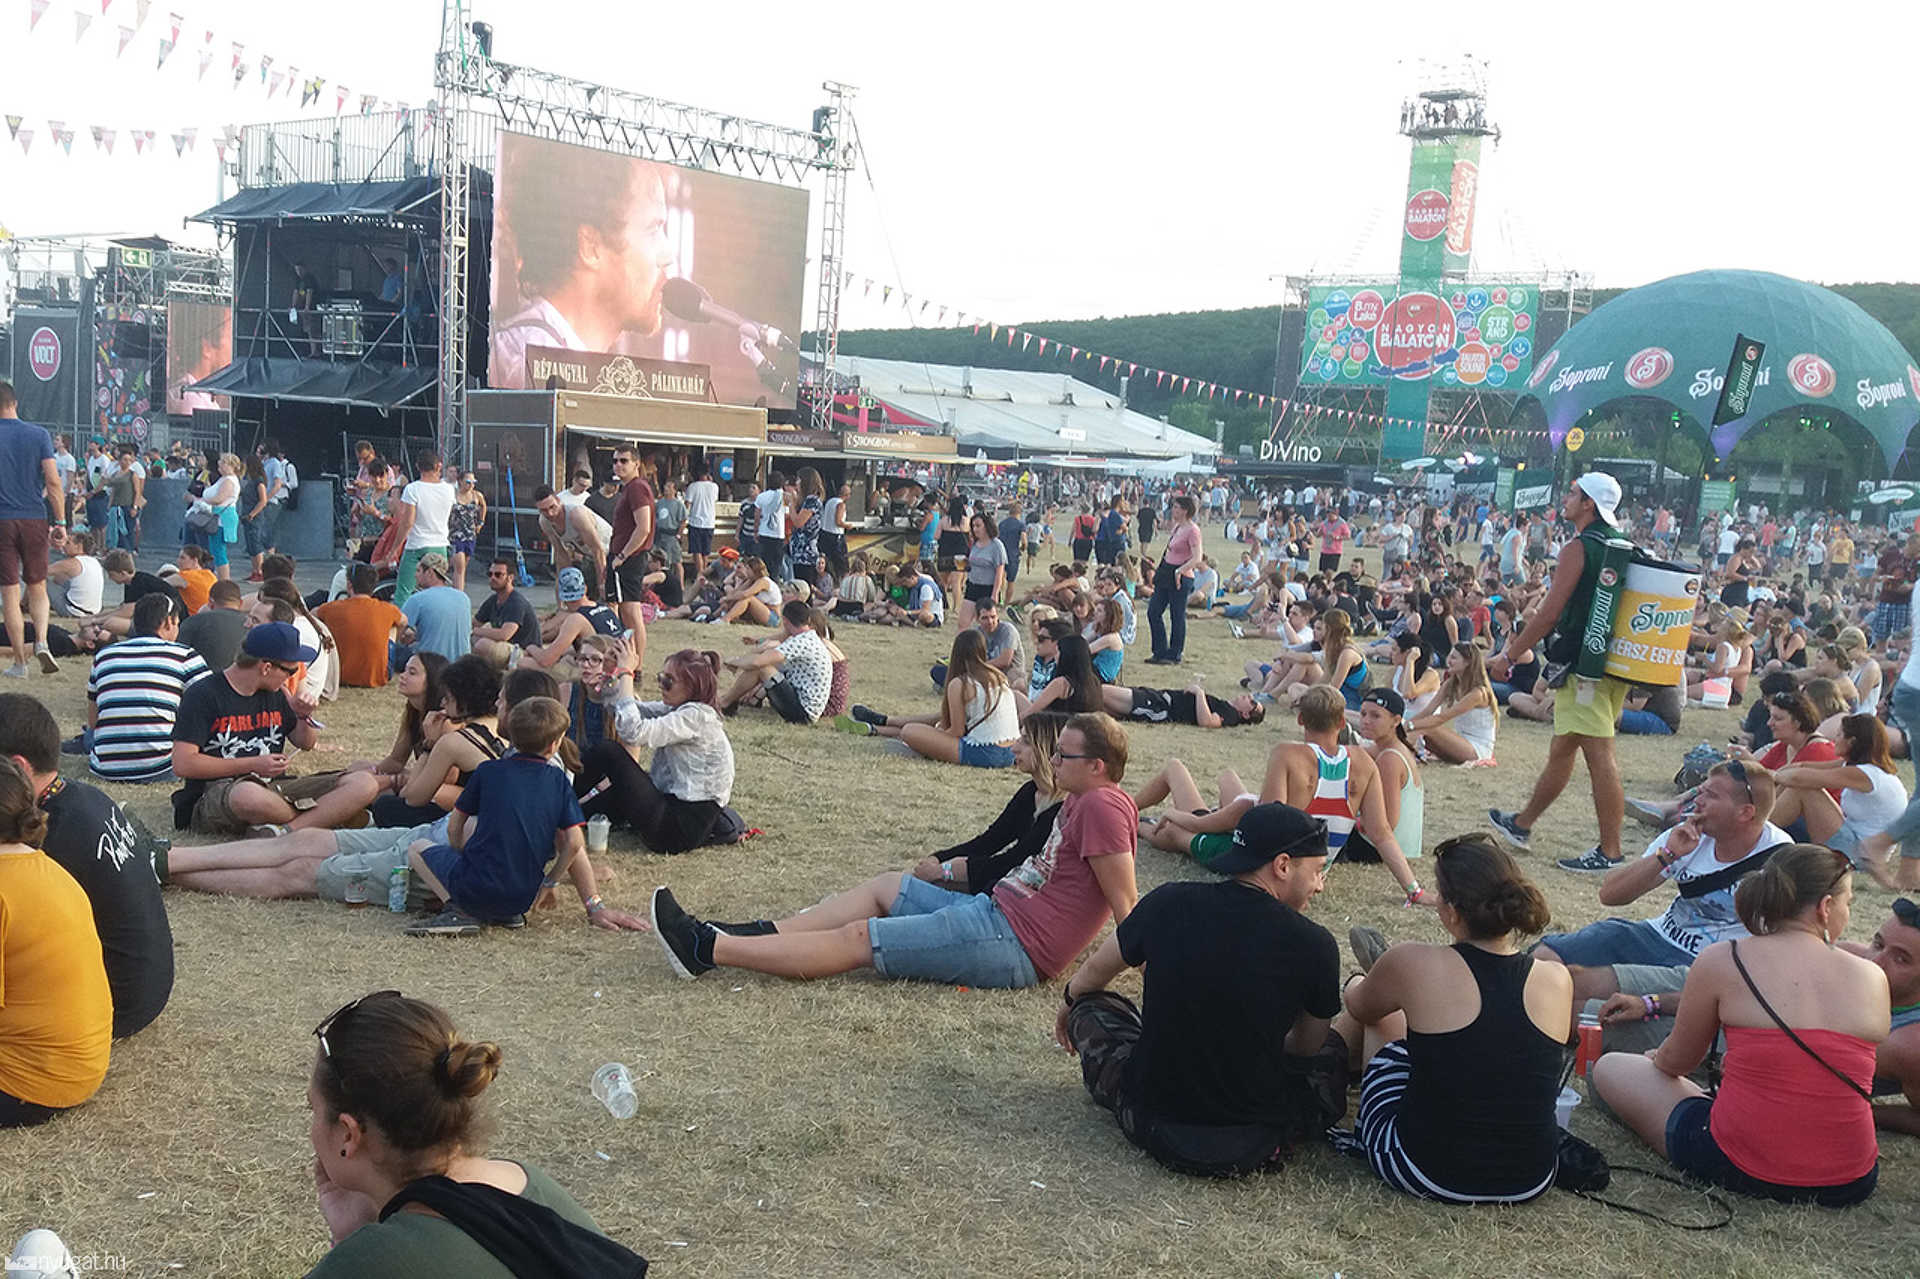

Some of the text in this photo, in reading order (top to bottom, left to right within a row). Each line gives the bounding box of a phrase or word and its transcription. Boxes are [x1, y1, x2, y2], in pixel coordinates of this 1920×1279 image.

[1381, 334, 1449, 347] BALATON
[34, 345, 55, 364] VOLT
[533, 358, 705, 396] RÉZANGYAL PÁLINKAHÁZ
[1549, 361, 1614, 395] Soproni
[1857, 377, 1906, 411] Soproni
[1260, 440, 1322, 462] DiVino
[1584, 587, 1613, 654] Soproni
[1650, 646, 1674, 664] EGY
[211, 711, 283, 732] PEARL JAM
